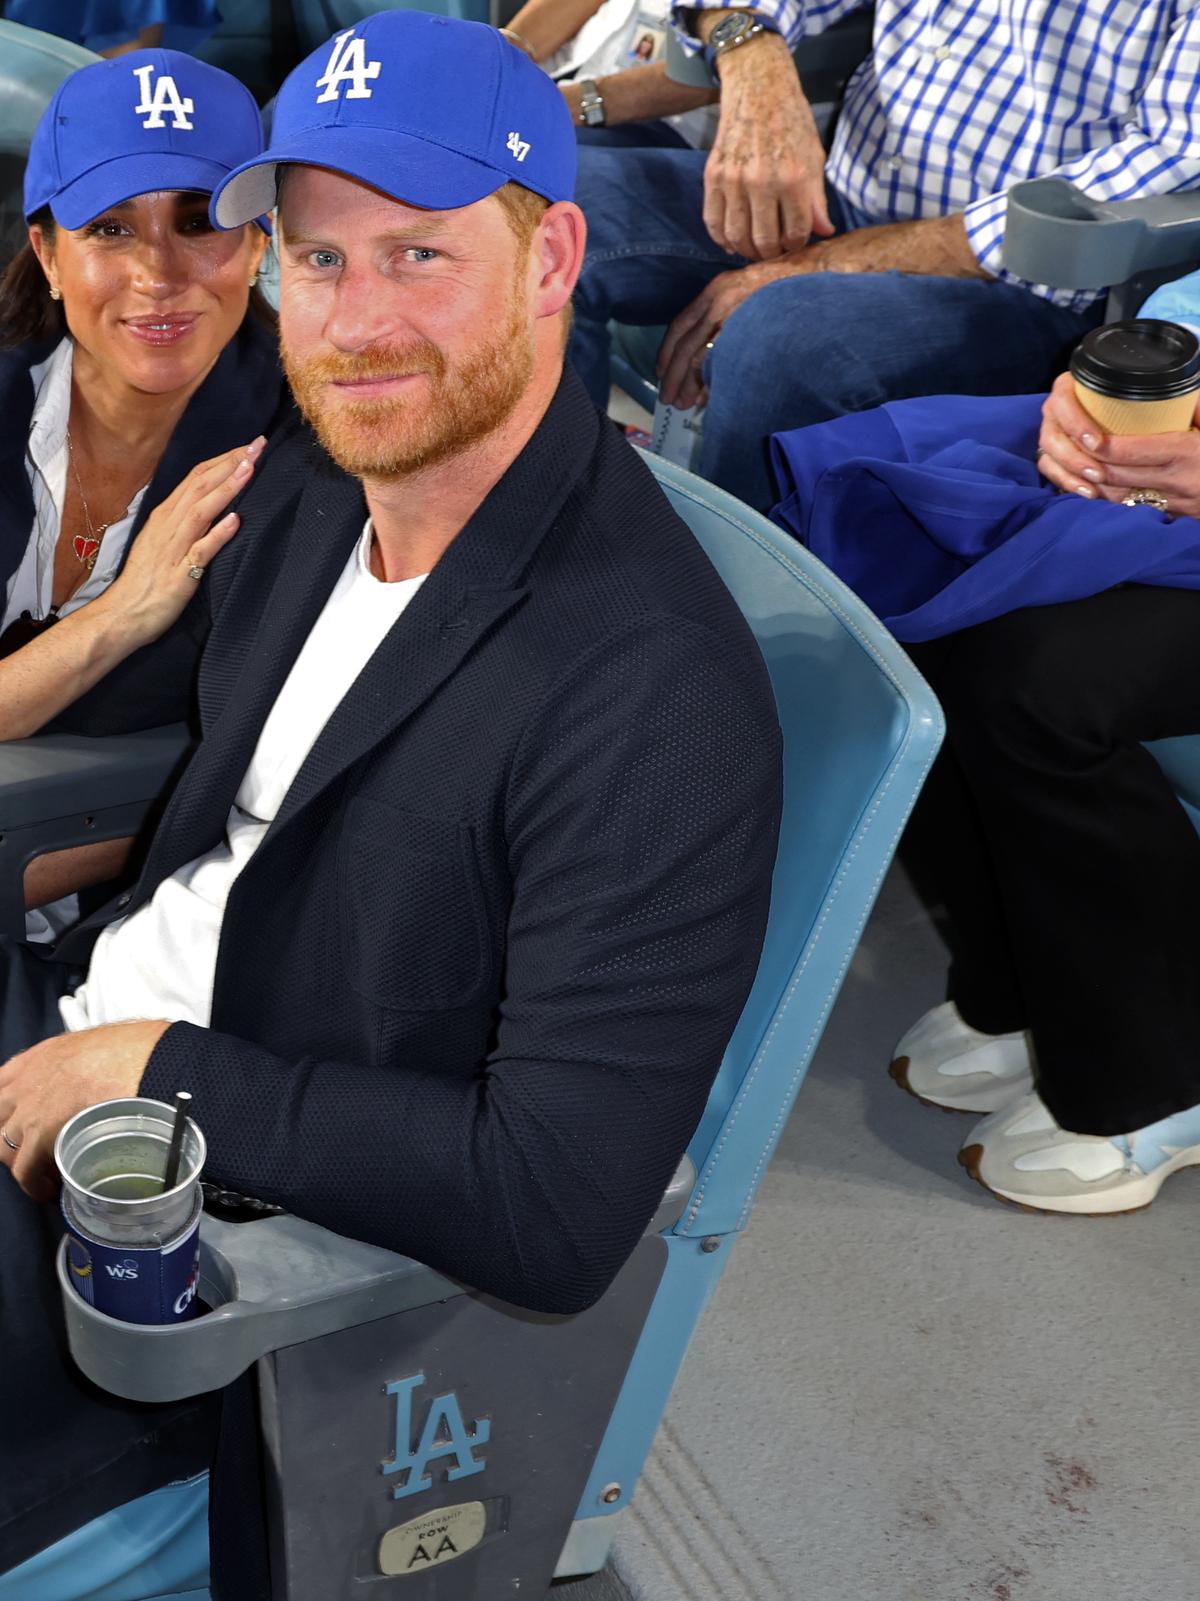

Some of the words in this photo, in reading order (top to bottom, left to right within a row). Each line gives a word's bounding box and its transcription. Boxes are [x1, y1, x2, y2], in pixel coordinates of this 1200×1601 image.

[315, 29, 382, 104] LA
[132, 64, 194, 130] LA
[105, 1264, 139, 1280] WS
[381, 1373, 491, 1500] LA
[405, 1510, 463, 1535] OWNERSHIP
[418, 1525, 449, 1540] ROW
[407, 1534, 458, 1569] AA
